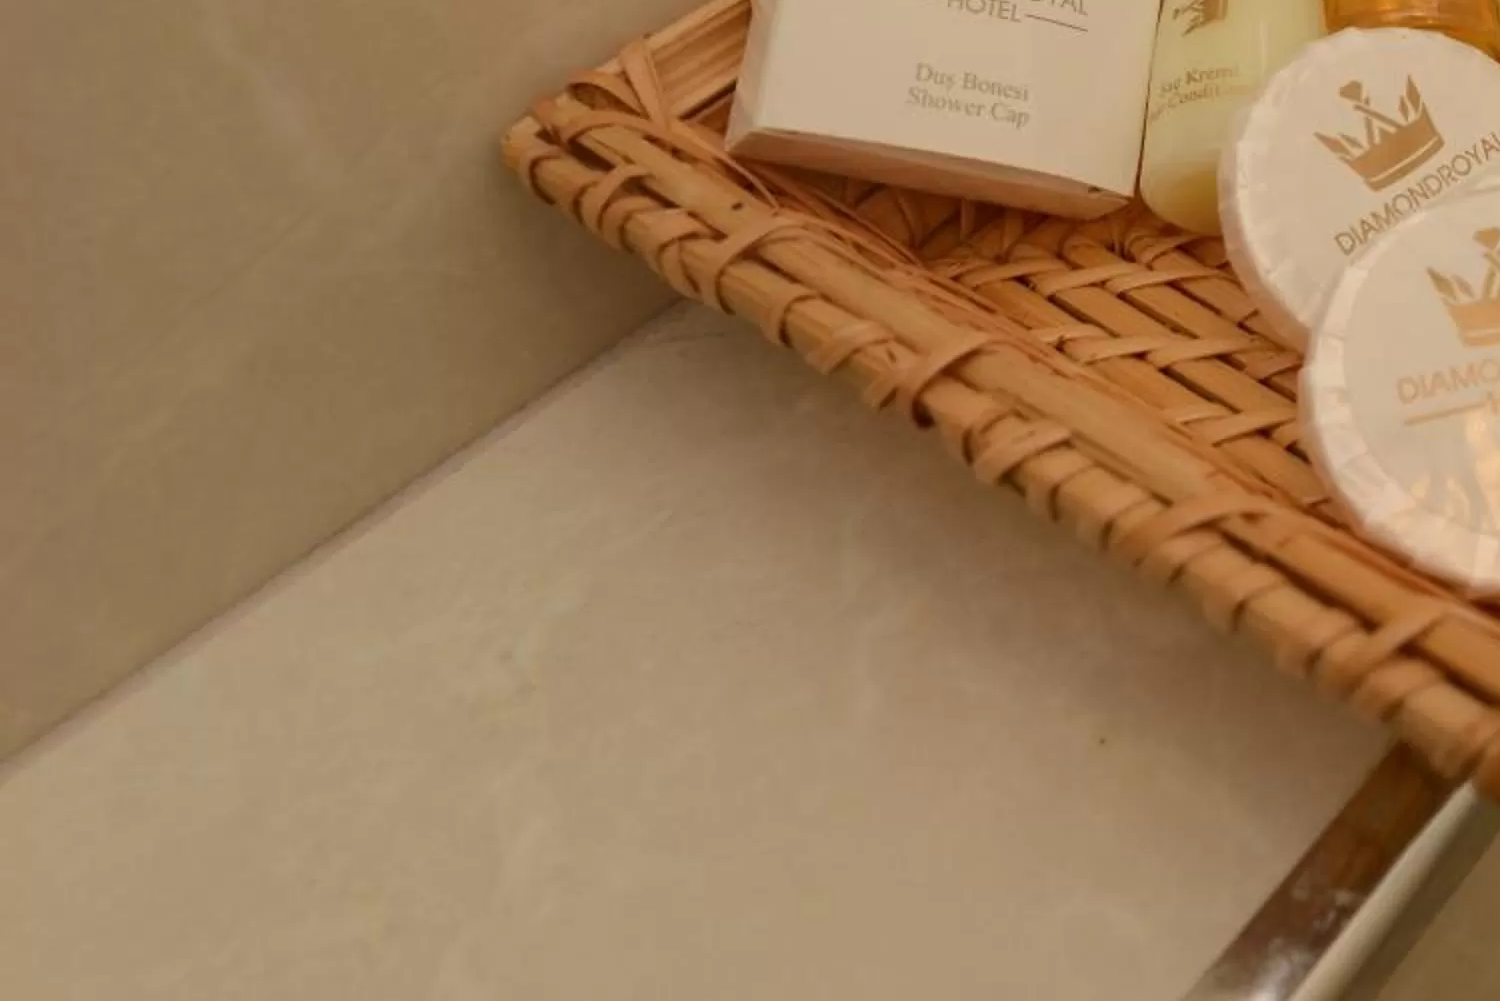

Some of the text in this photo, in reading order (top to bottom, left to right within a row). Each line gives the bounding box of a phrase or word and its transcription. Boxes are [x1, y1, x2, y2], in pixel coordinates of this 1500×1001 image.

[962, 70, 1030, 102] Bonesi
[905, 85, 1031, 130] Shower Cap
